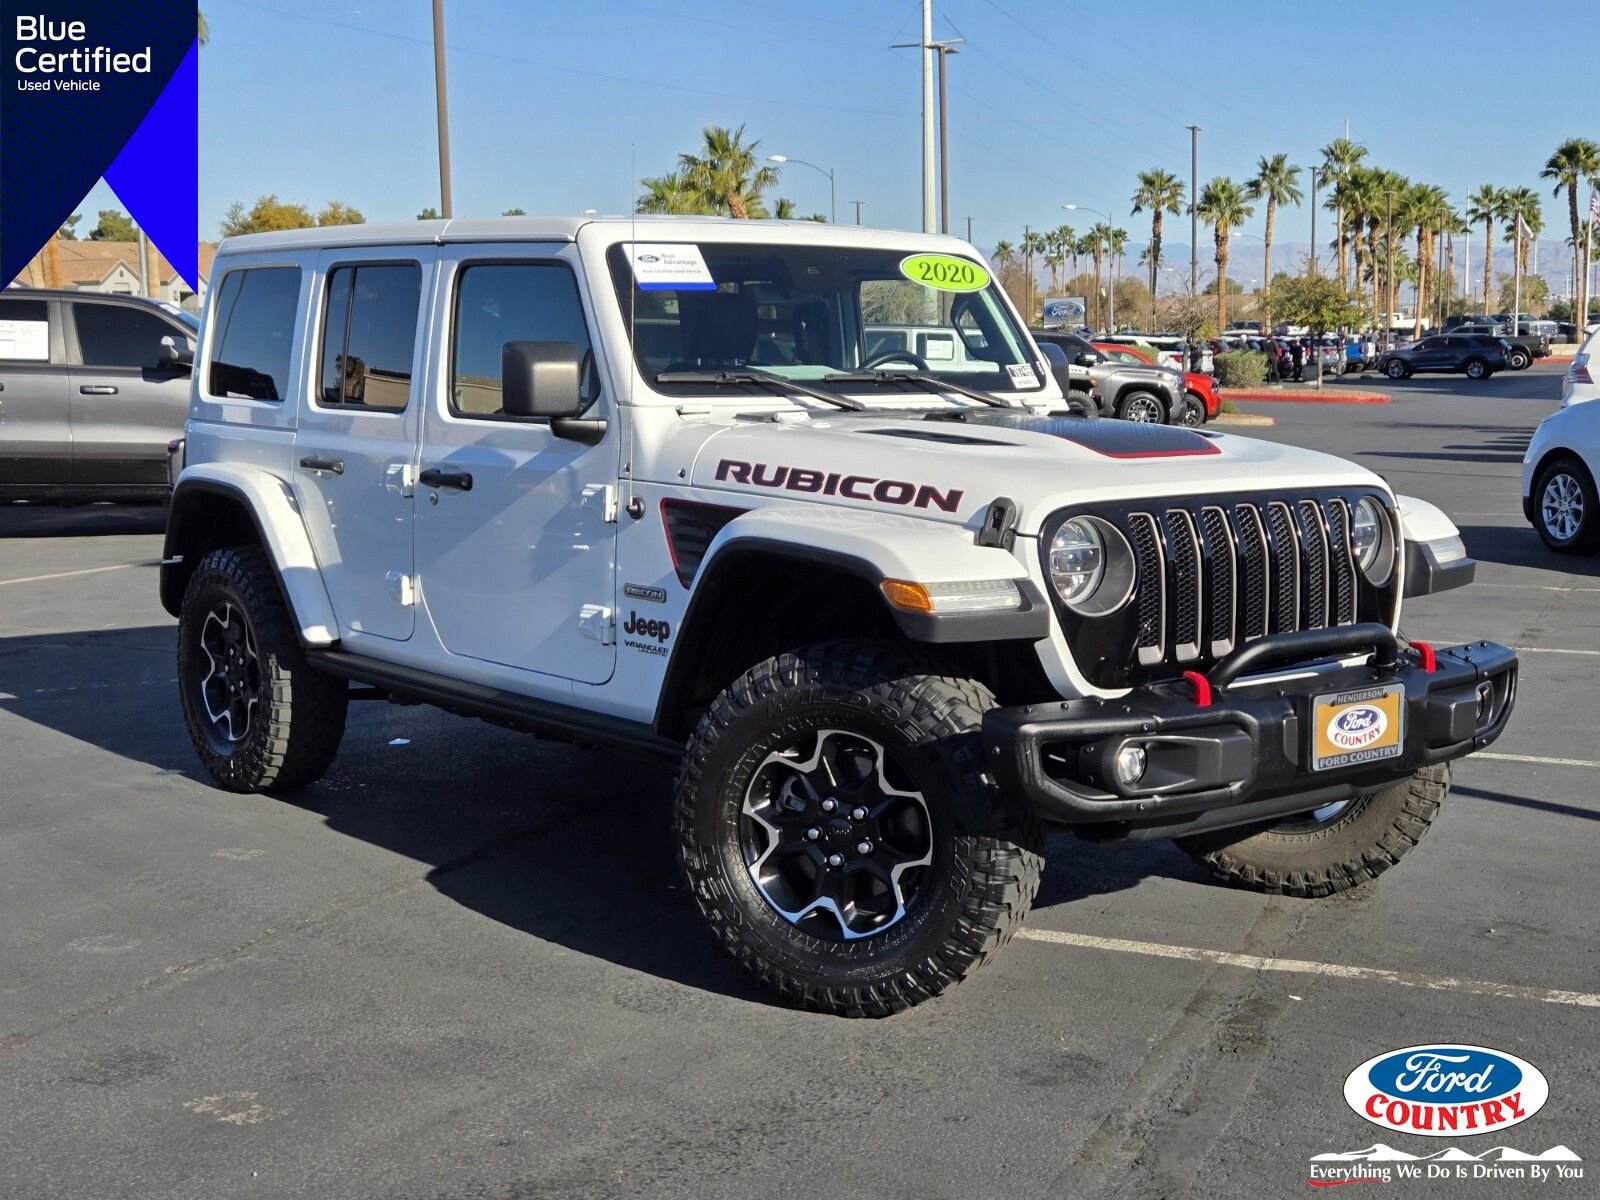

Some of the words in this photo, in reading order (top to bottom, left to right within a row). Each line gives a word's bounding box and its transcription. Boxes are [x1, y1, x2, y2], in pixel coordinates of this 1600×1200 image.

[919, 262, 975, 284] 2020
[715, 458, 965, 513] RUBICON
[624, 610, 670, 643] Jeep
[624, 640, 669, 655] WRANGLER
[1337, 688, 1384, 704] HENDERSON
[1343, 710, 1373, 730] Ford
[1334, 725, 1381, 746] COUNTRY
[1320, 755, 1348, 768] FORD
[1350, 746, 1397, 762] COUNTRY
